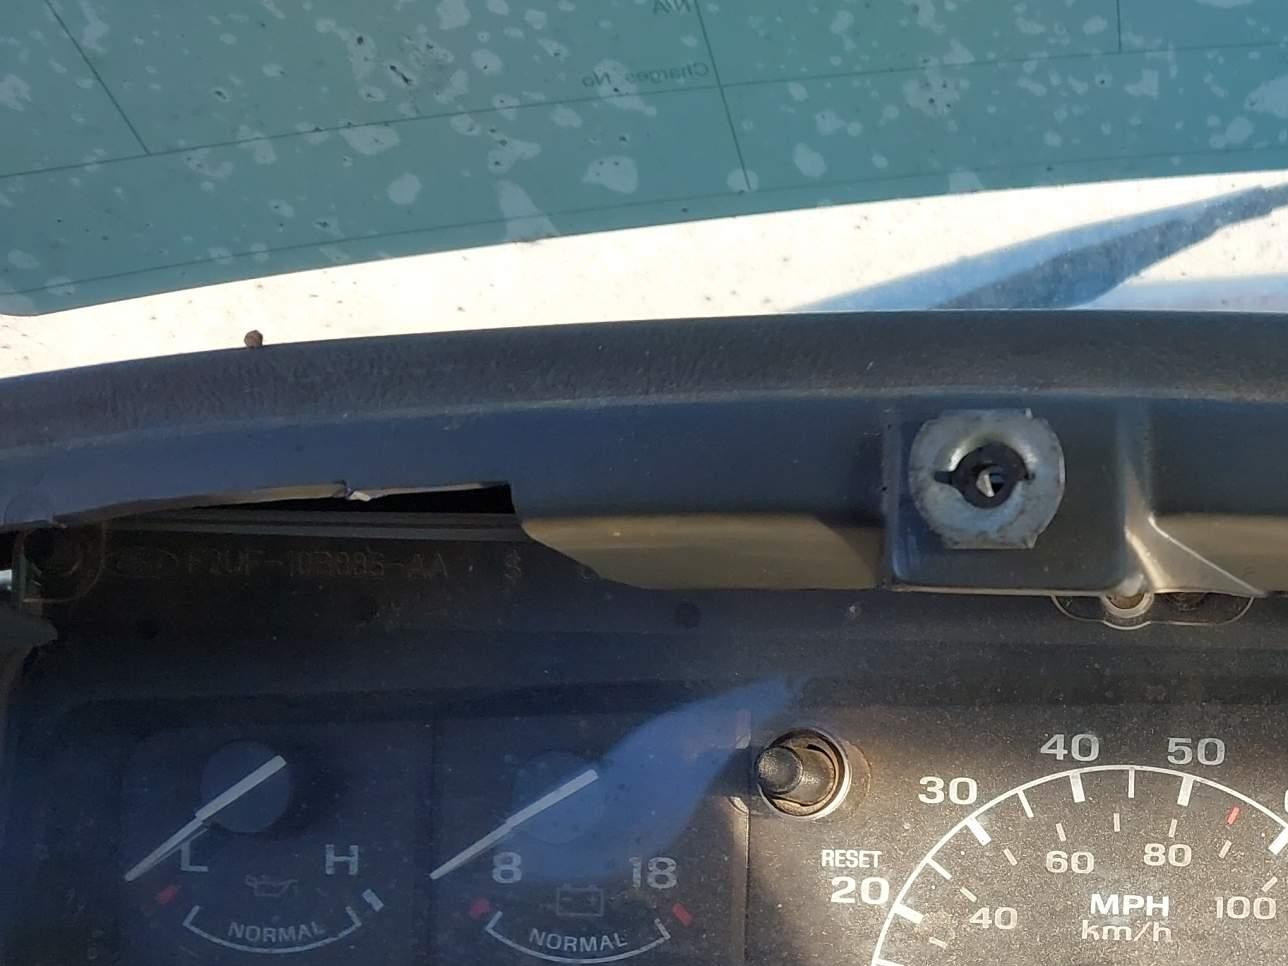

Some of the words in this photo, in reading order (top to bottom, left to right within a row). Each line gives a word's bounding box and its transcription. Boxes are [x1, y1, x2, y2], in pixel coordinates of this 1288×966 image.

[1040, 733, 1101, 761] 40
[1168, 737, 1226, 766] 50
[918, 776, 978, 805] 30
[325, 845, 359, 875] H
[493, 853, 523, 884] 8
[821, 850, 882, 869] RESET
[1045, 851, 1095, 875] 60
[1143, 844, 1192, 868] 80
[631, 857, 678, 888] 18
[830, 876, 891, 906] 20
[1090, 894, 1170, 917] MPH
[1215, 896, 1277, 921] 100
[968, 907, 1018, 931] 40
[1081, 919, 1172, 943] km/h
[228, 921, 325, 943] NORMAL
[529, 927, 629, 953] NORMAL
